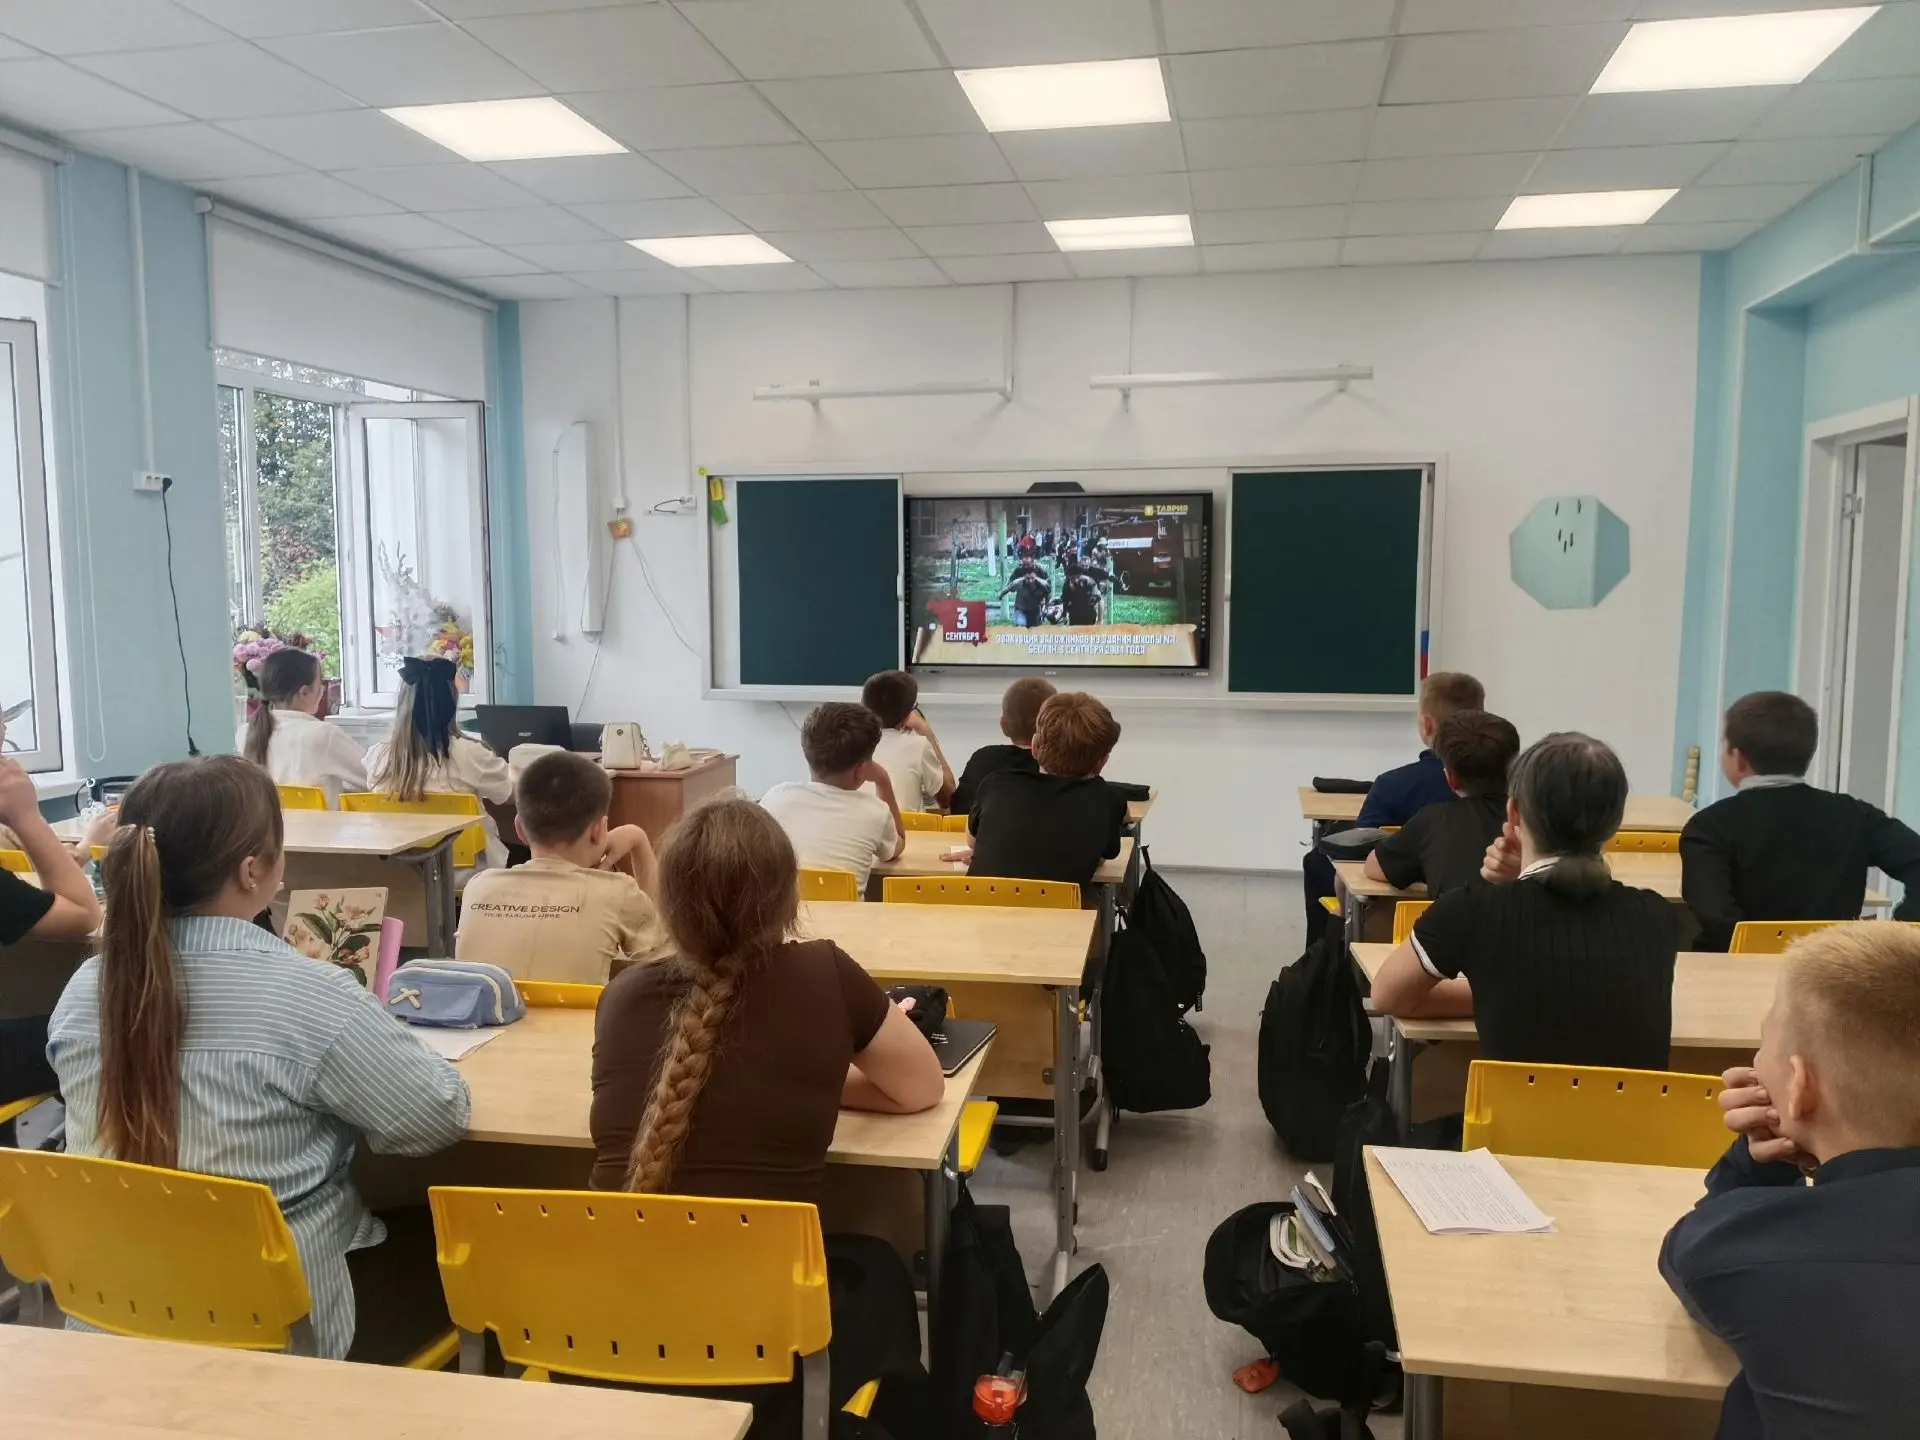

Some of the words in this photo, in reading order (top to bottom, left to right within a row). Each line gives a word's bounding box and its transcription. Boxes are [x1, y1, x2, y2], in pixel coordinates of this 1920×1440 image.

[1156, 504, 1188, 512] ТАВРИЯ
[956, 607, 968, 629] 3
[945, 631, 980, 641] СЕНТЯБРЯ
[1133, 634, 1162, 644] ШКОЛЫ
[1126, 645, 1146, 655] ГОДА
[470, 903, 528, 913] CREATIVE
[530, 905, 580, 913] DESIGN
